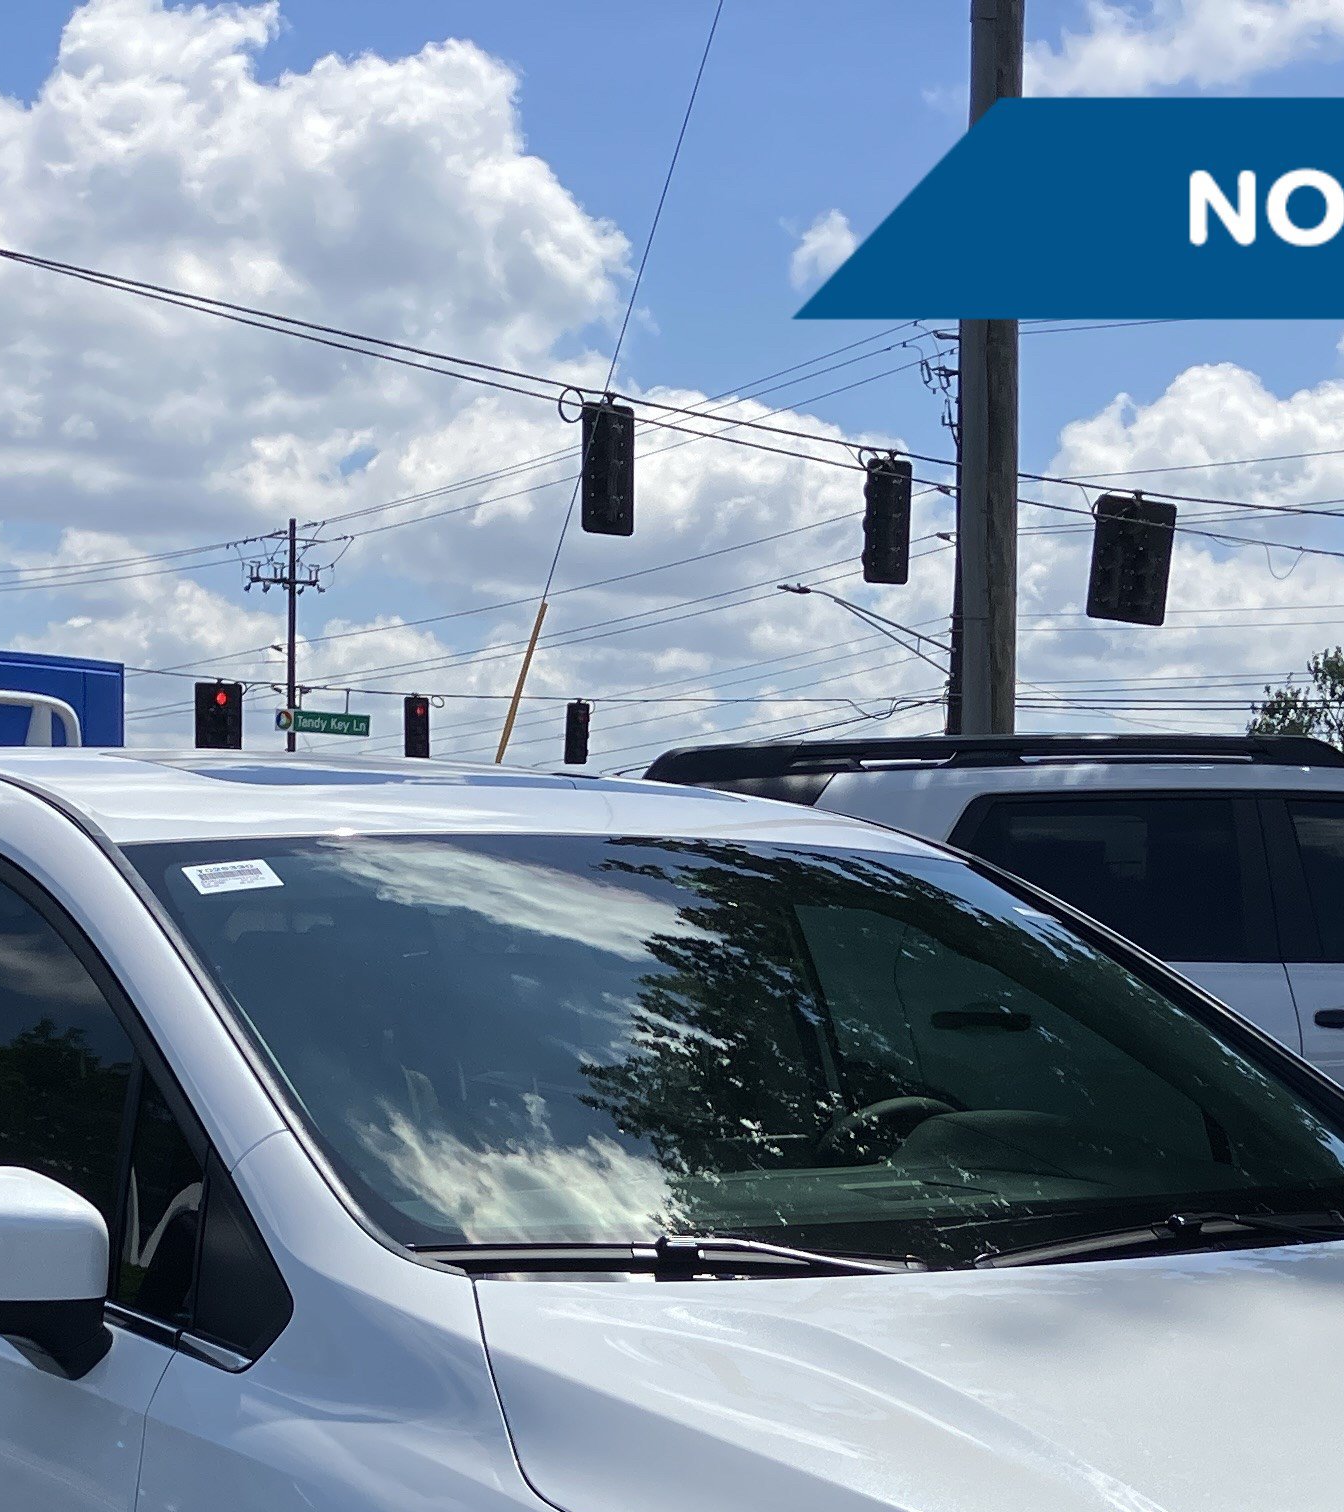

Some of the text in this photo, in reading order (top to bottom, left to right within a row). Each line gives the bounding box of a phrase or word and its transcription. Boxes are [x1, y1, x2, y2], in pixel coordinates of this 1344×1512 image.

[297, 716, 366, 732] Tandy Key Ln
